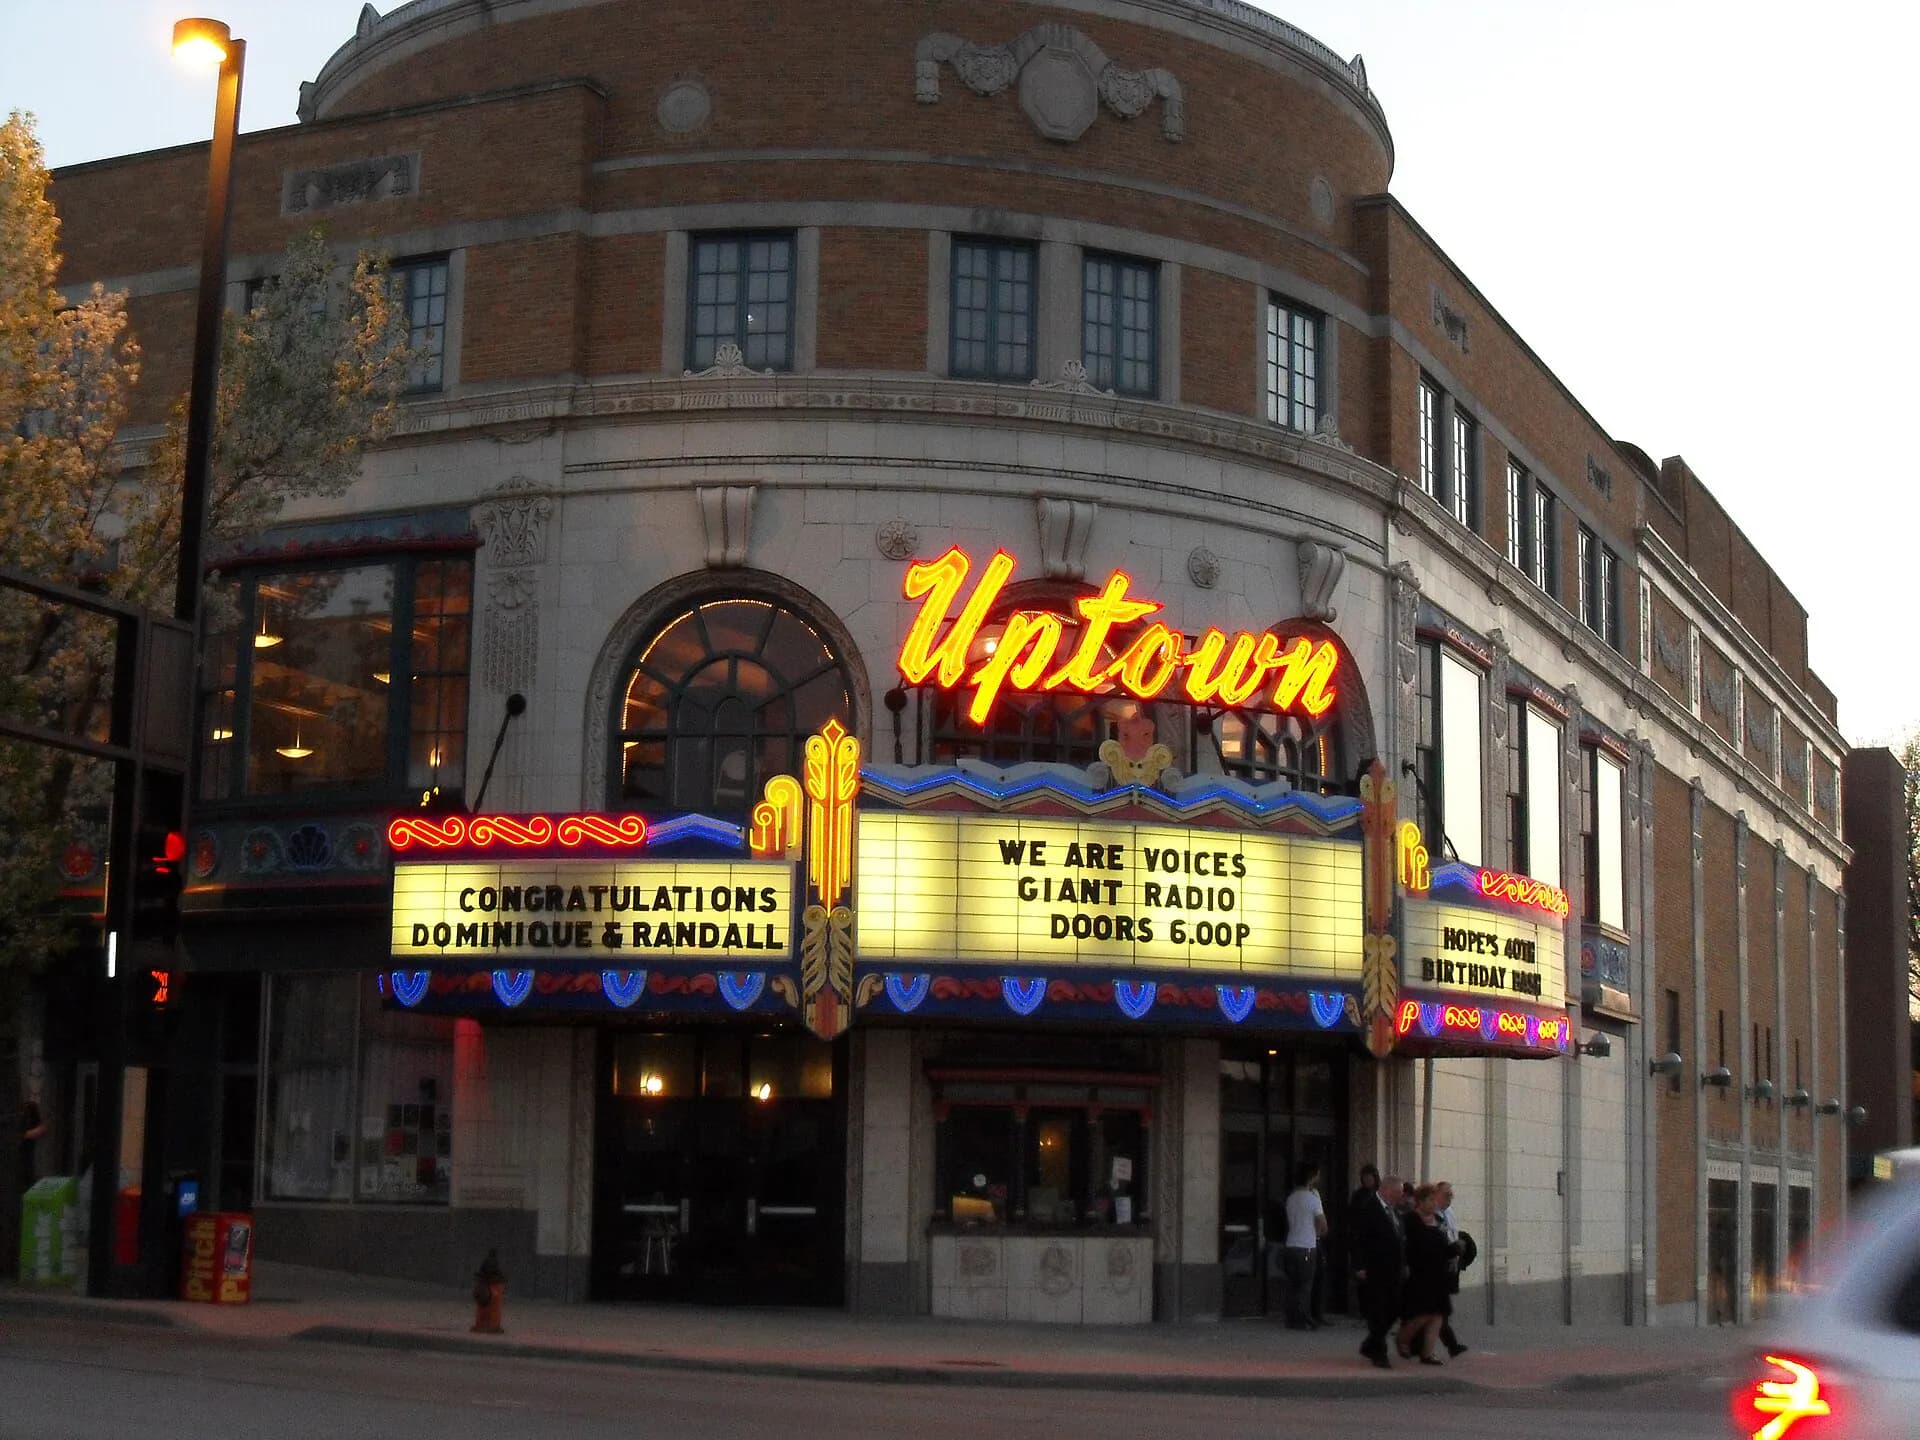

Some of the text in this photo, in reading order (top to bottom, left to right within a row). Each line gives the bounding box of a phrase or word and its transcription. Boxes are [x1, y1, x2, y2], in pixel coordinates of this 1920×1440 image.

[898, 545, 1340, 726] Uptown
[998, 839, 1247, 878] WE ARE VOICES
[459, 885, 778, 913] CONGRATULATIONS
[1018, 876, 1235, 911] GIANT RADIO
[411, 921, 783, 949] DOMINIQUE & RANDALL
[1051, 913, 1153, 942] DOORS
[1443, 927, 1499, 957] HOPE'S
[1422, 957, 1506, 989] BIRTHDAY
